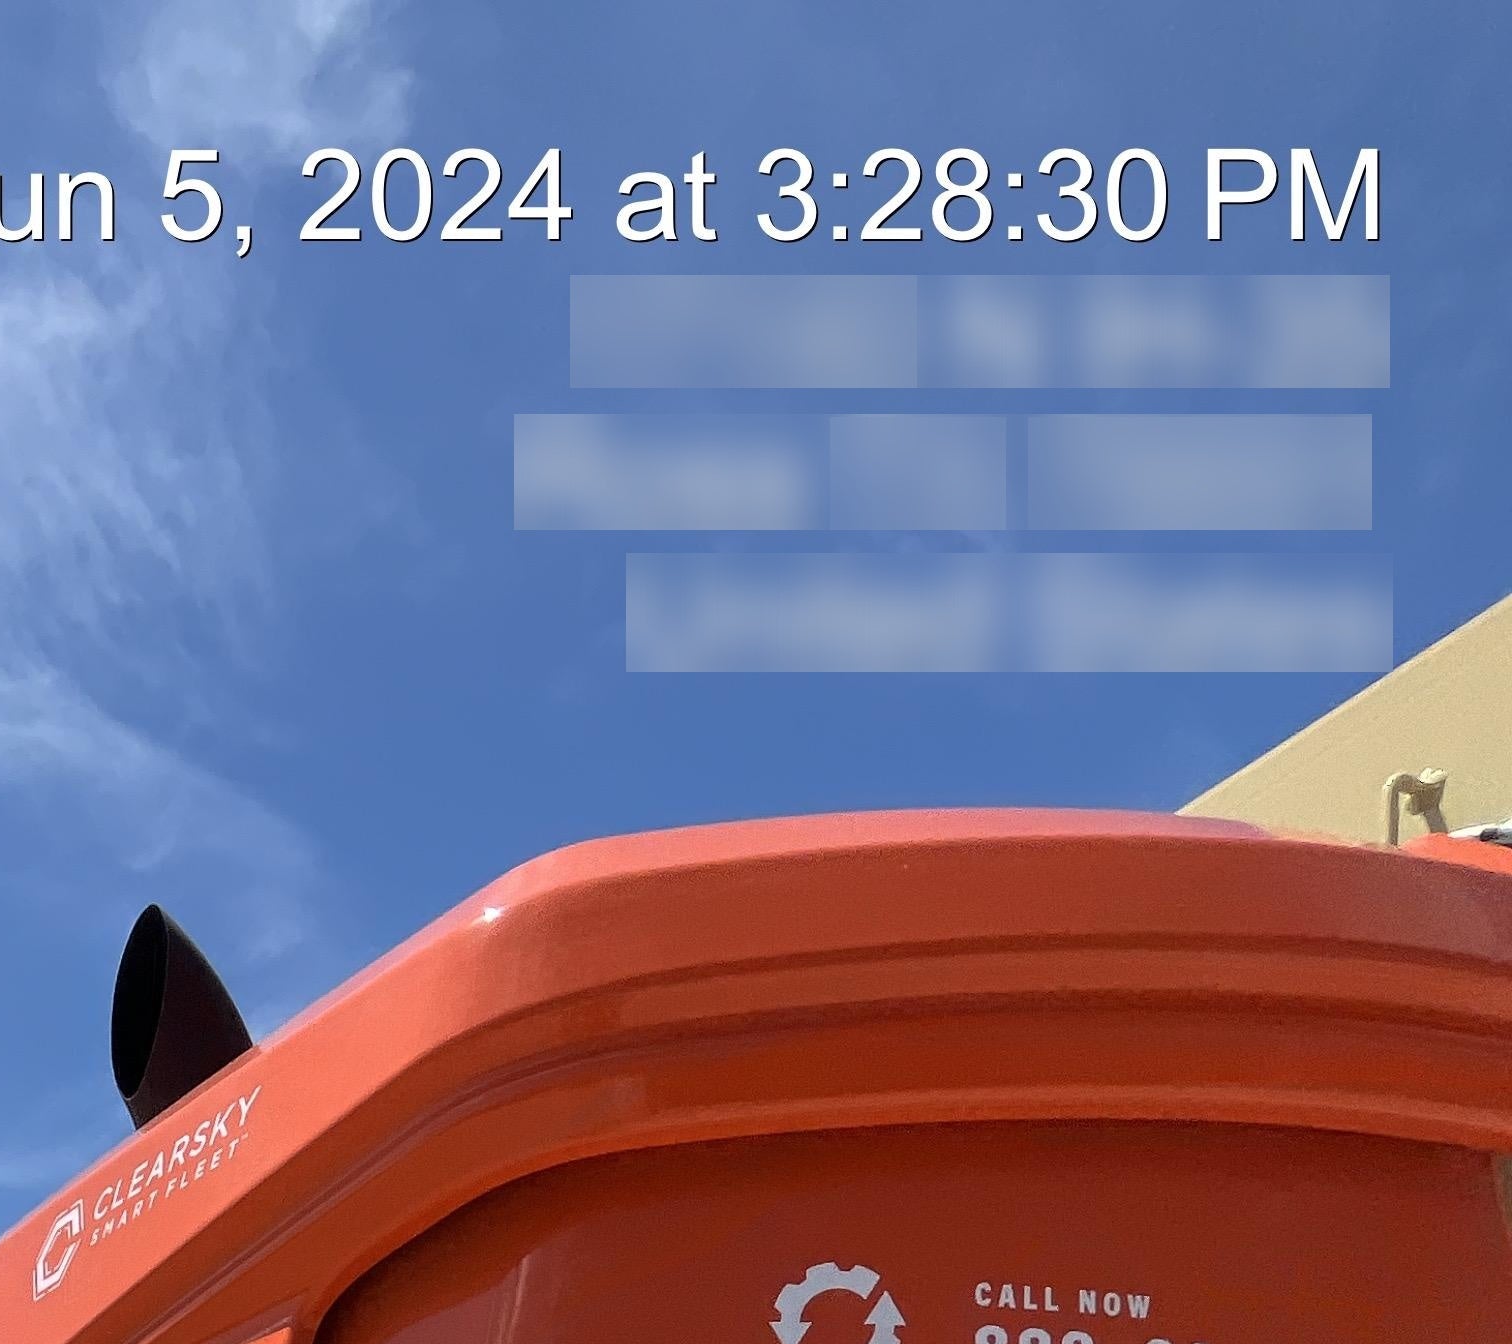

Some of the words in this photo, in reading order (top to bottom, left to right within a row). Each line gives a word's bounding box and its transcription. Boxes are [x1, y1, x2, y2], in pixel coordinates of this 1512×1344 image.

[89, 1190, 158, 1247] SMART
[165, 1138, 239, 1198] FLEET
[93, 1085, 262, 1220] CLEARSKY
[974, 1282, 1060, 1312] CALL
[1079, 1289, 1152, 1319] NOW
